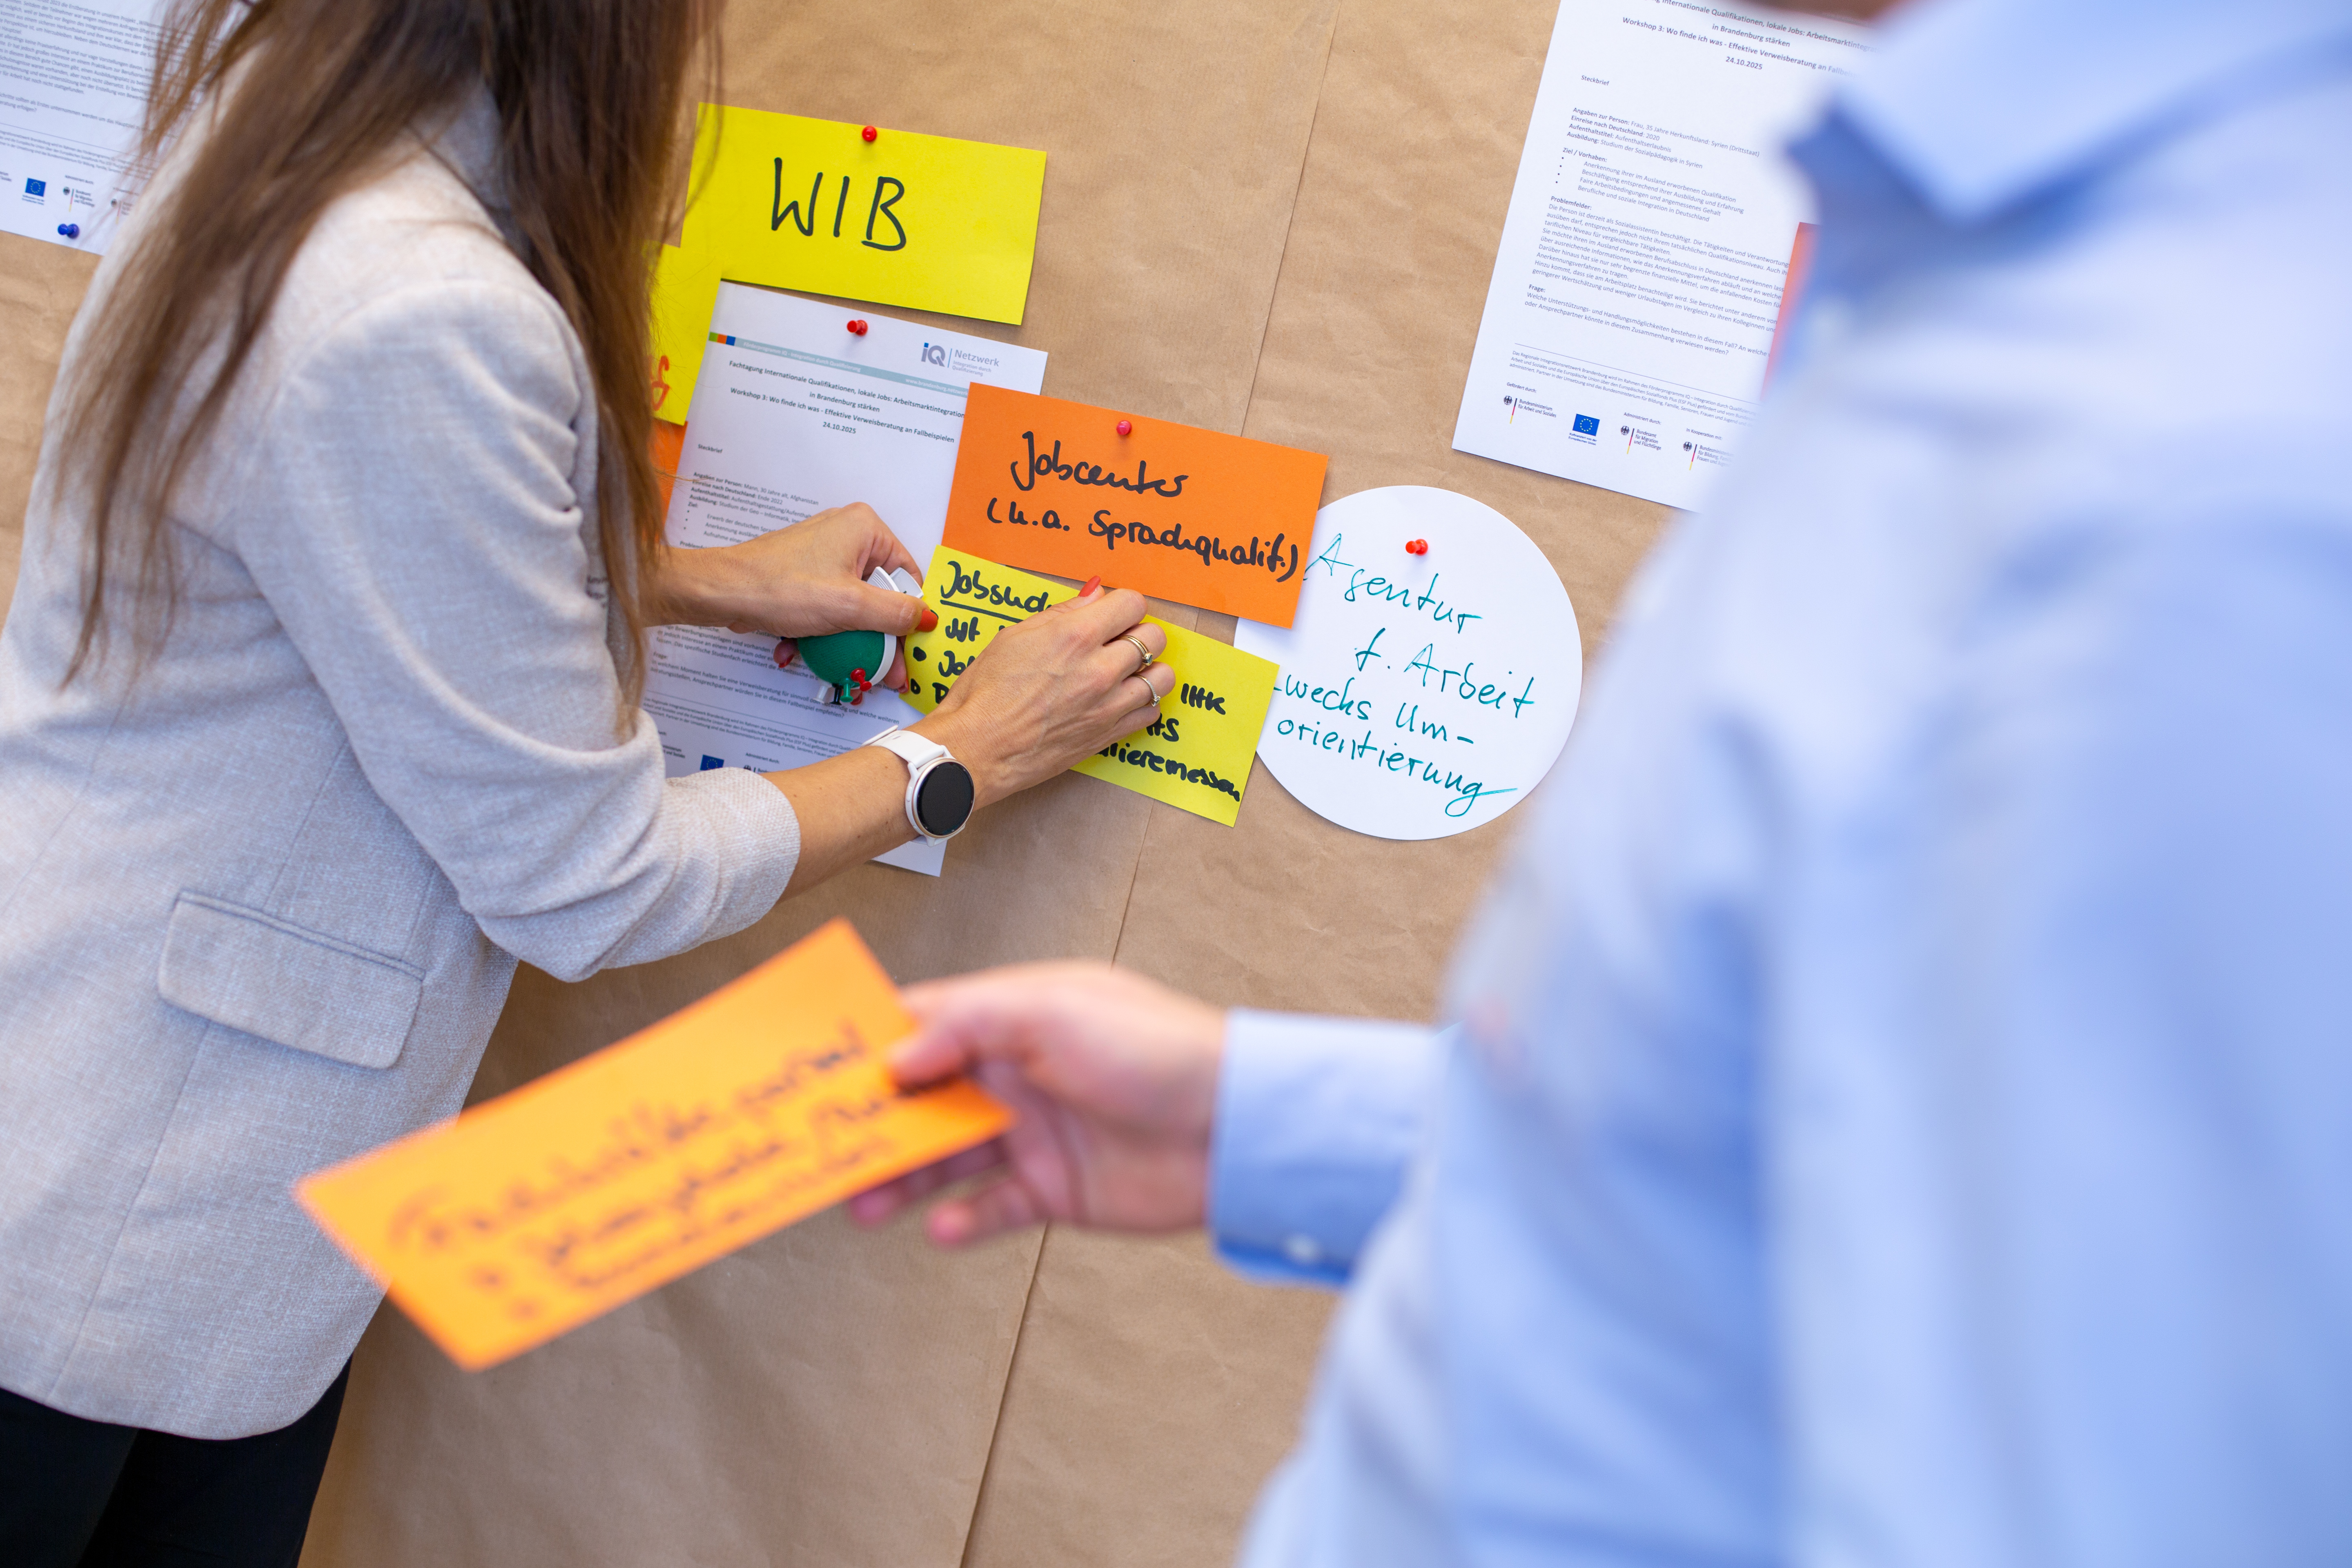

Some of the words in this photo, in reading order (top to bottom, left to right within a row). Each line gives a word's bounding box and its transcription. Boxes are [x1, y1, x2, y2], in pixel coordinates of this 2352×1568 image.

[1711, 8, 1765, 28] Qualifikationen,
[1766, 20, 1787, 32] lokale
[1787, 26, 1806, 36] Jobs:
[1623, 17, 1657, 31] Workshop
[1666, 27, 1678, 35] Wo
[1679, 30, 1697, 40] finde
[1697, 34, 1708, 42] ich
[1728, 42, 1758, 55] Effektive
[1760, 49, 1817, 70] Verweisberatung
[1720, 25, 1764, 42] Brandenburg
[1764, 37, 1791, 47] stärken
[1725, 56, 1763, 70] 24.10.2025
[1580, 75, 1610, 86] Steckbrief
[1570, 115, 1593, 125] Einreise
[1608, 124, 1645, 138] Deutschland:
[1645, 133, 1660, 141] 2020
[1572, 107, 1598, 118] Angaben
[1608, 115, 1630, 125] Person:
[1630, 120, 1645, 130] Frau,
[1653, 127, 1669, 135] Jahre
[1669, 130, 1711, 145] Herkunftsland:
[1711, 140, 1728, 149] Syrien
[1729, 144, 1760, 158] (Drittstaat)
[1568, 123, 1614, 139] Aufenthaltstitel:
[1615, 134, 1672, 153] Aufenthaltserlaubnis
[1566, 131, 1599, 145] Ausbildung:
[1600, 139, 1624, 149] Studium
[1634, 147, 1678, 163] Sozialpädagogik
[1685, 160, 1703, 169] Syrien
[1578, 151, 1608, 163] Vorhaben:
[1583, 161, 1621, 176] Anerkennung
[1621, 169, 1635, 178] ihrer
[1643, 176, 1666, 185] Ausland
[1666, 182, 1700, 194] erworbenen
[1701, 189, 1736, 203] Qualifikation
[771, 157, 907, 252] WIB
[1550, 195, 1592, 210] Problemfelder:
[1577, 185, 1606, 196] Berufliche
[1617, 196, 1637, 204] soziale
[1637, 199, 1668, 212] Integration
[1675, 209, 1710, 222] Deutschland
[1528, 284, 1546, 293] Frage:
[953, 360, 978, 370] Integration
[954, 349, 1000, 367] Netzwerk
[951, 365, 984, 377] Qualifizierung
[728, 360, 764, 374] Fachtagung
[764, 368, 807, 383] Internationale
[808, 378, 856, 395] Qualifikationen,
[857, 388, 876, 398] lokale
[876, 393, 893, 402] Jobs:
[893, 397, 965, 419] Arbeitsmarktintegration
[1506, 382, 1525, 390] Gefördert
[816, 393, 857, 408] Brandenburg
[857, 403, 880, 412] stärken
[1519, 398, 1553, 411] Bundesministerium
[730, 387, 761, 400] Workshop
[780, 398, 797, 407] finde
[824, 408, 852, 420] Effektive
[853, 414, 904, 433] Verweisberatung
[913, 428, 955, 443] Fallbeispielen
[1542, 410, 1557, 418] Soziales
[1623, 412, 1649, 422] Administriert
[822, 421, 856, 434] 24.10.2025
[1636, 428, 1657, 439] Bundesamt
[1690, 429, 1714, 439] Kooperation
[697, 443, 723, 454] Steckbrief
[1641, 435, 1659, 444] Migration
[1641, 441, 1662, 451] Flüchtlinge
[1303, 533, 1483, 634] Agentur
[1355, 627, 1391, 672] f.
[1403, 643, 1536, 719] Arbeit
[1396, 702, 1474, 744] Um-
[1277, 719, 1519, 817] orientierung
